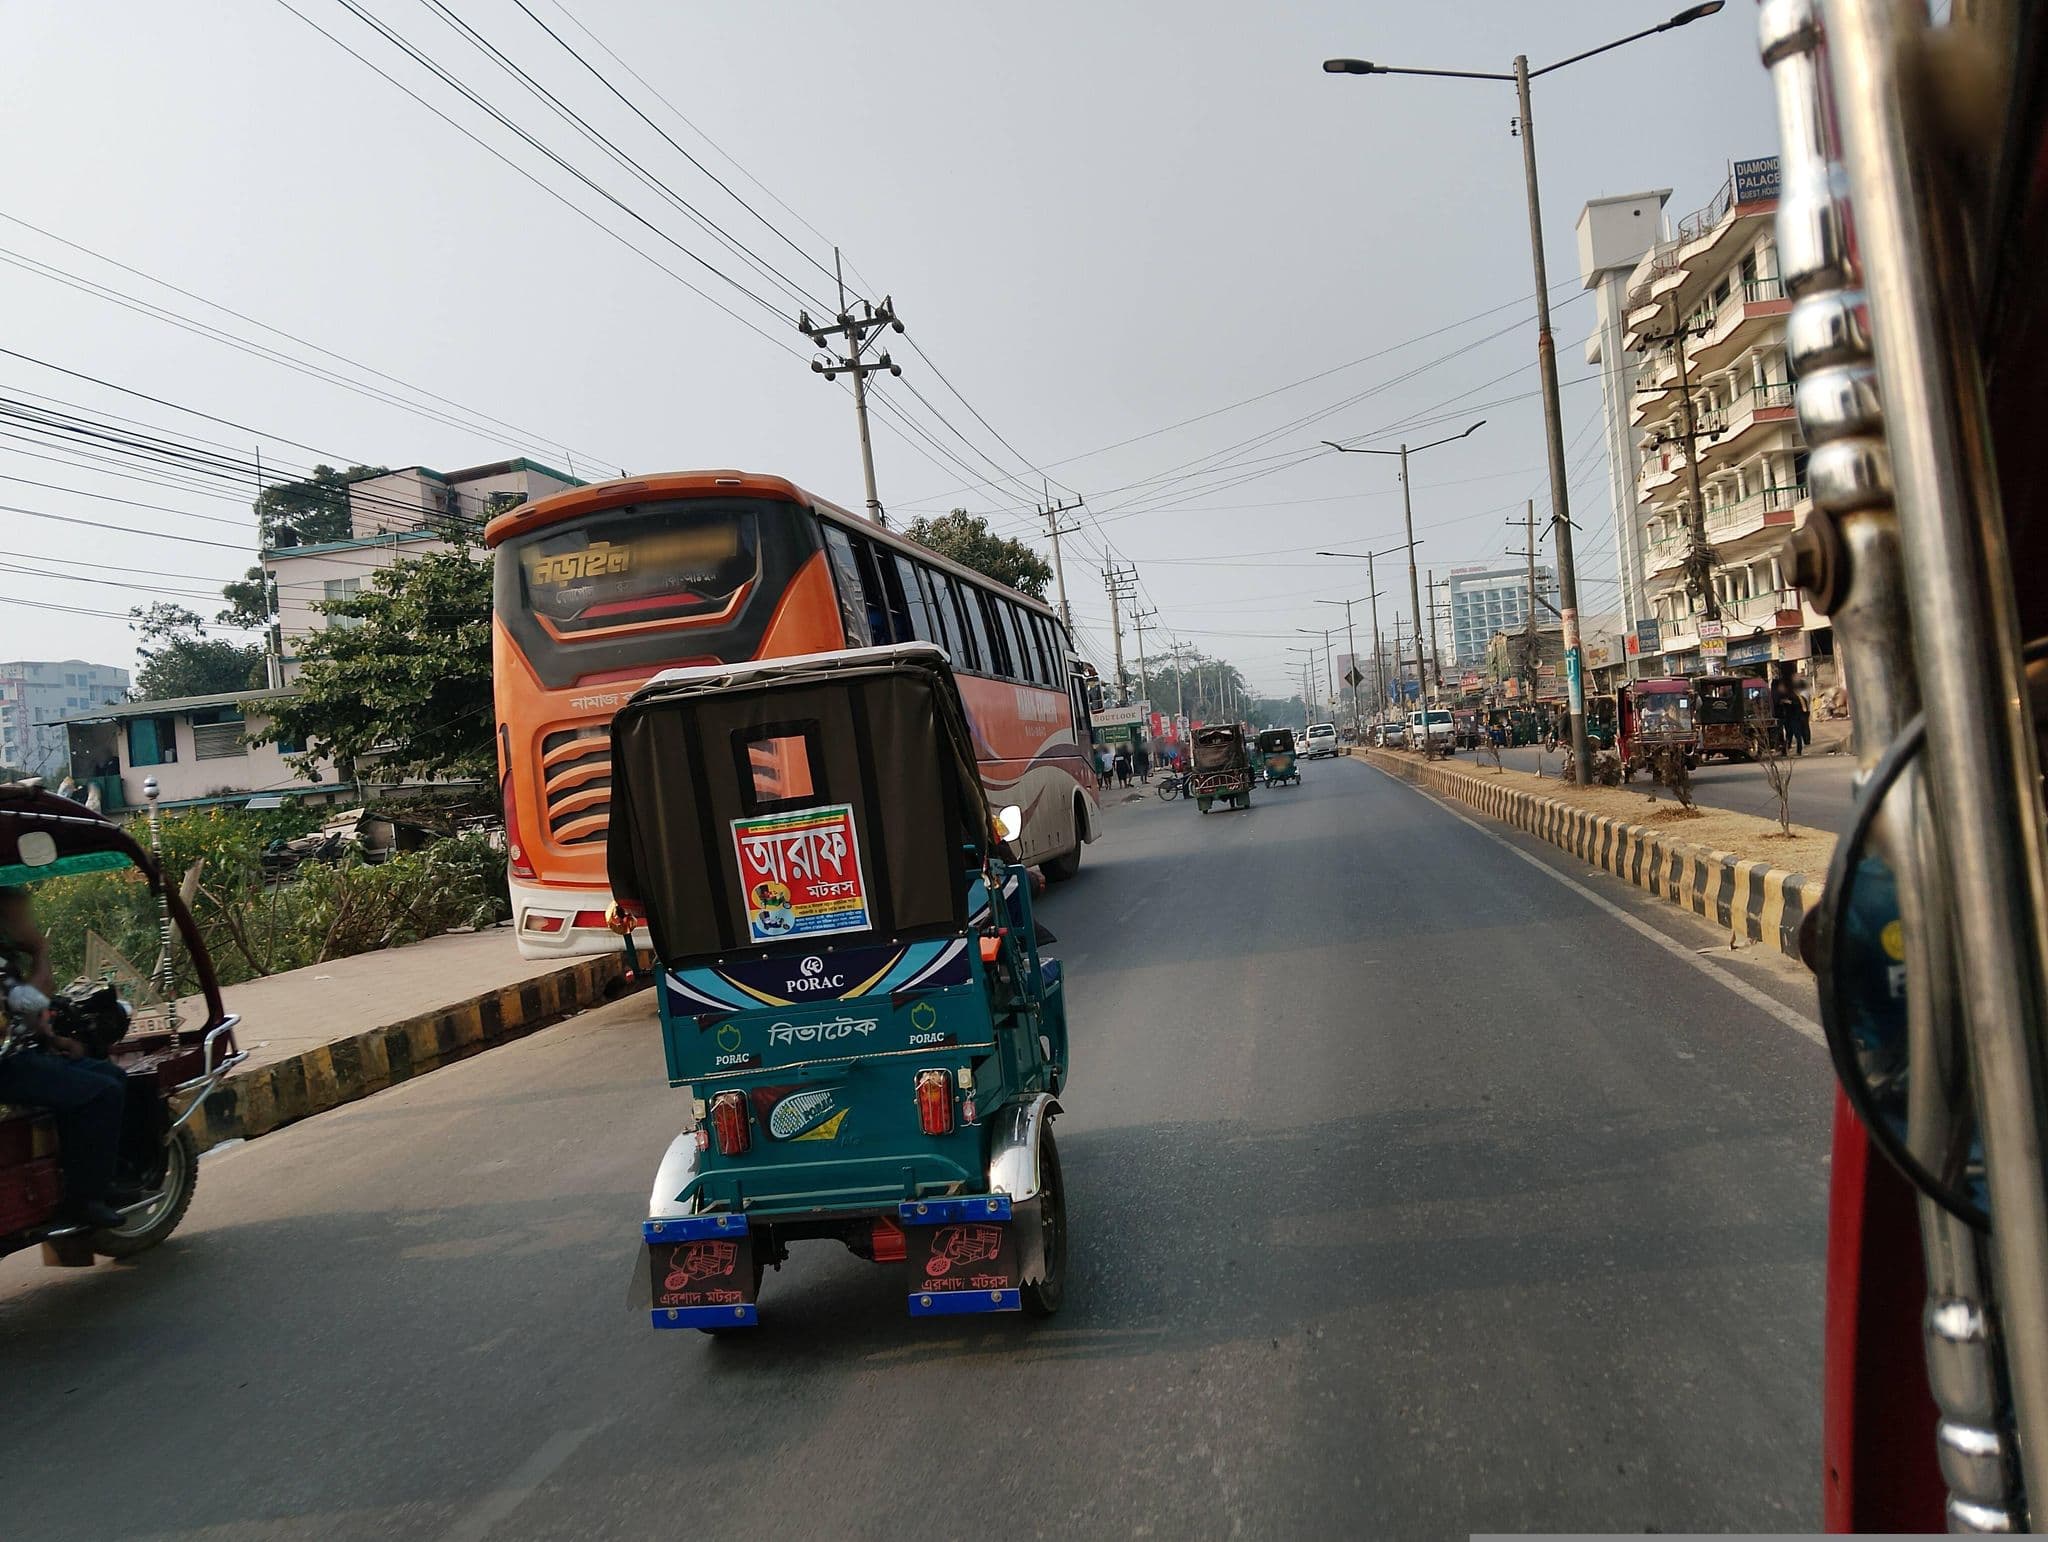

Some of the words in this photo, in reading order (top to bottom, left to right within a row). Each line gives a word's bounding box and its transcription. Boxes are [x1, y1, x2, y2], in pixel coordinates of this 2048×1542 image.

[1736, 159, 1780, 176] DIAMOND
[1738, 173, 1782, 189] PALACE
[532, 541, 630, 587] নড়াইল
[569, 693, 618, 710] নামাজ
[741, 824, 847, 884] আরাফ
[806, 880, 856, 897] মটরস্
[786, 974, 845, 993] PORAC
[768, 1015, 879, 1047] বিভাটেক
[909, 1031, 945, 1045] PORAC
[715, 1052, 750, 1066] PORAC
